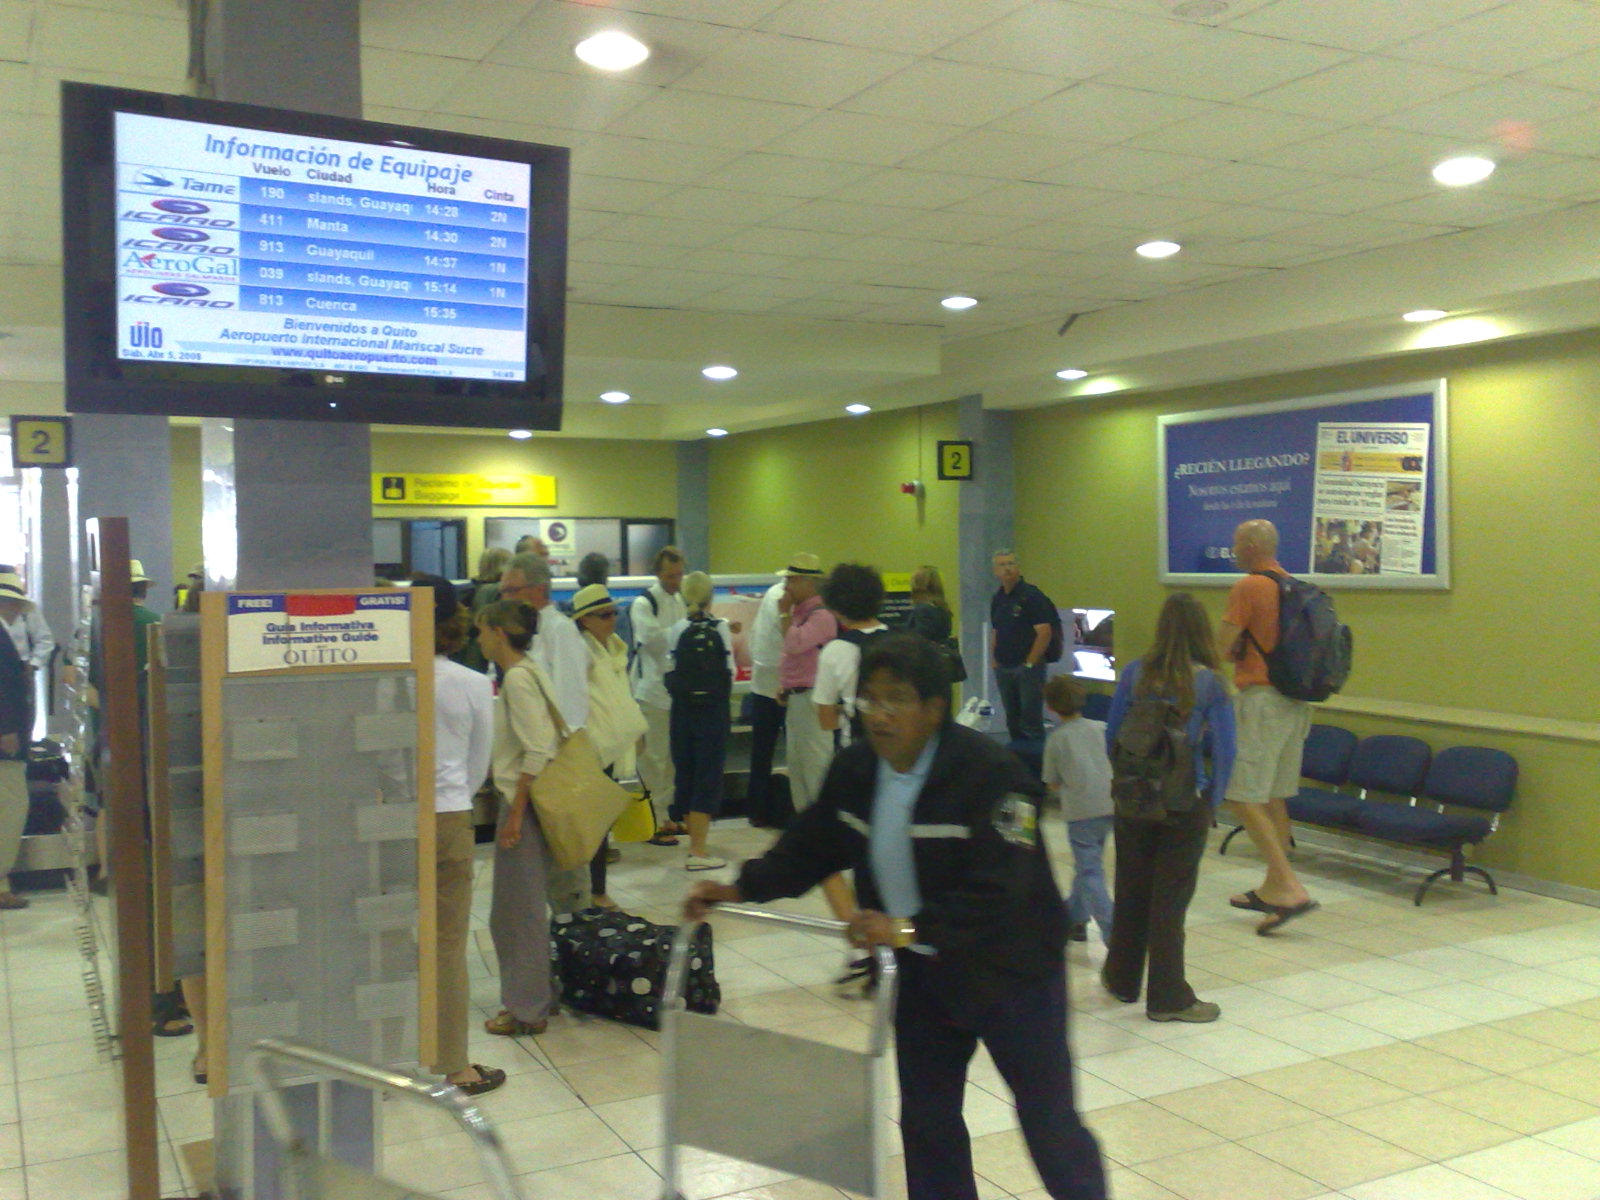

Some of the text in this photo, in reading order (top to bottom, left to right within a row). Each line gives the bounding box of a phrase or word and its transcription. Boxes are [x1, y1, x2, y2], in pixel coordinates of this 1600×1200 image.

[204, 133, 473, 185] Información de Equipaje
[181, 177, 236, 195] Tame
[252, 162, 514, 202] Vuelo Ciudad Hora Cinta
[491, 211, 508, 224] 2N
[259, 214, 507, 249] 411 Manta 14:30 2N
[123, 251, 238, 276] AeroGal
[259, 240, 506, 274] 913 Guayaquil 14:37 1N
[424, 281, 457, 294] 15:14
[490, 287, 506, 298] 1N
[306, 297, 357, 312] Cuenca
[284, 318, 418, 338] Bienvenidos a Quito
[219, 328, 484, 356] Aeropuerto Internacional Mariscal Sucre
[271, 347, 438, 366] www.quitoaeropuerto.com
[32, 430, 50, 454] 2
[1336, 431, 1349, 444] EL
[1351, 431, 1409, 445] UNIVERSO
[951, 451, 962, 470] 2
[1230, 452, 1311, 471] LLEGANDO?
[359, 596, 406, 606] GRATIS!
[300, 620, 374, 631] Informativa
[262, 632, 379, 645] Informative Guide
